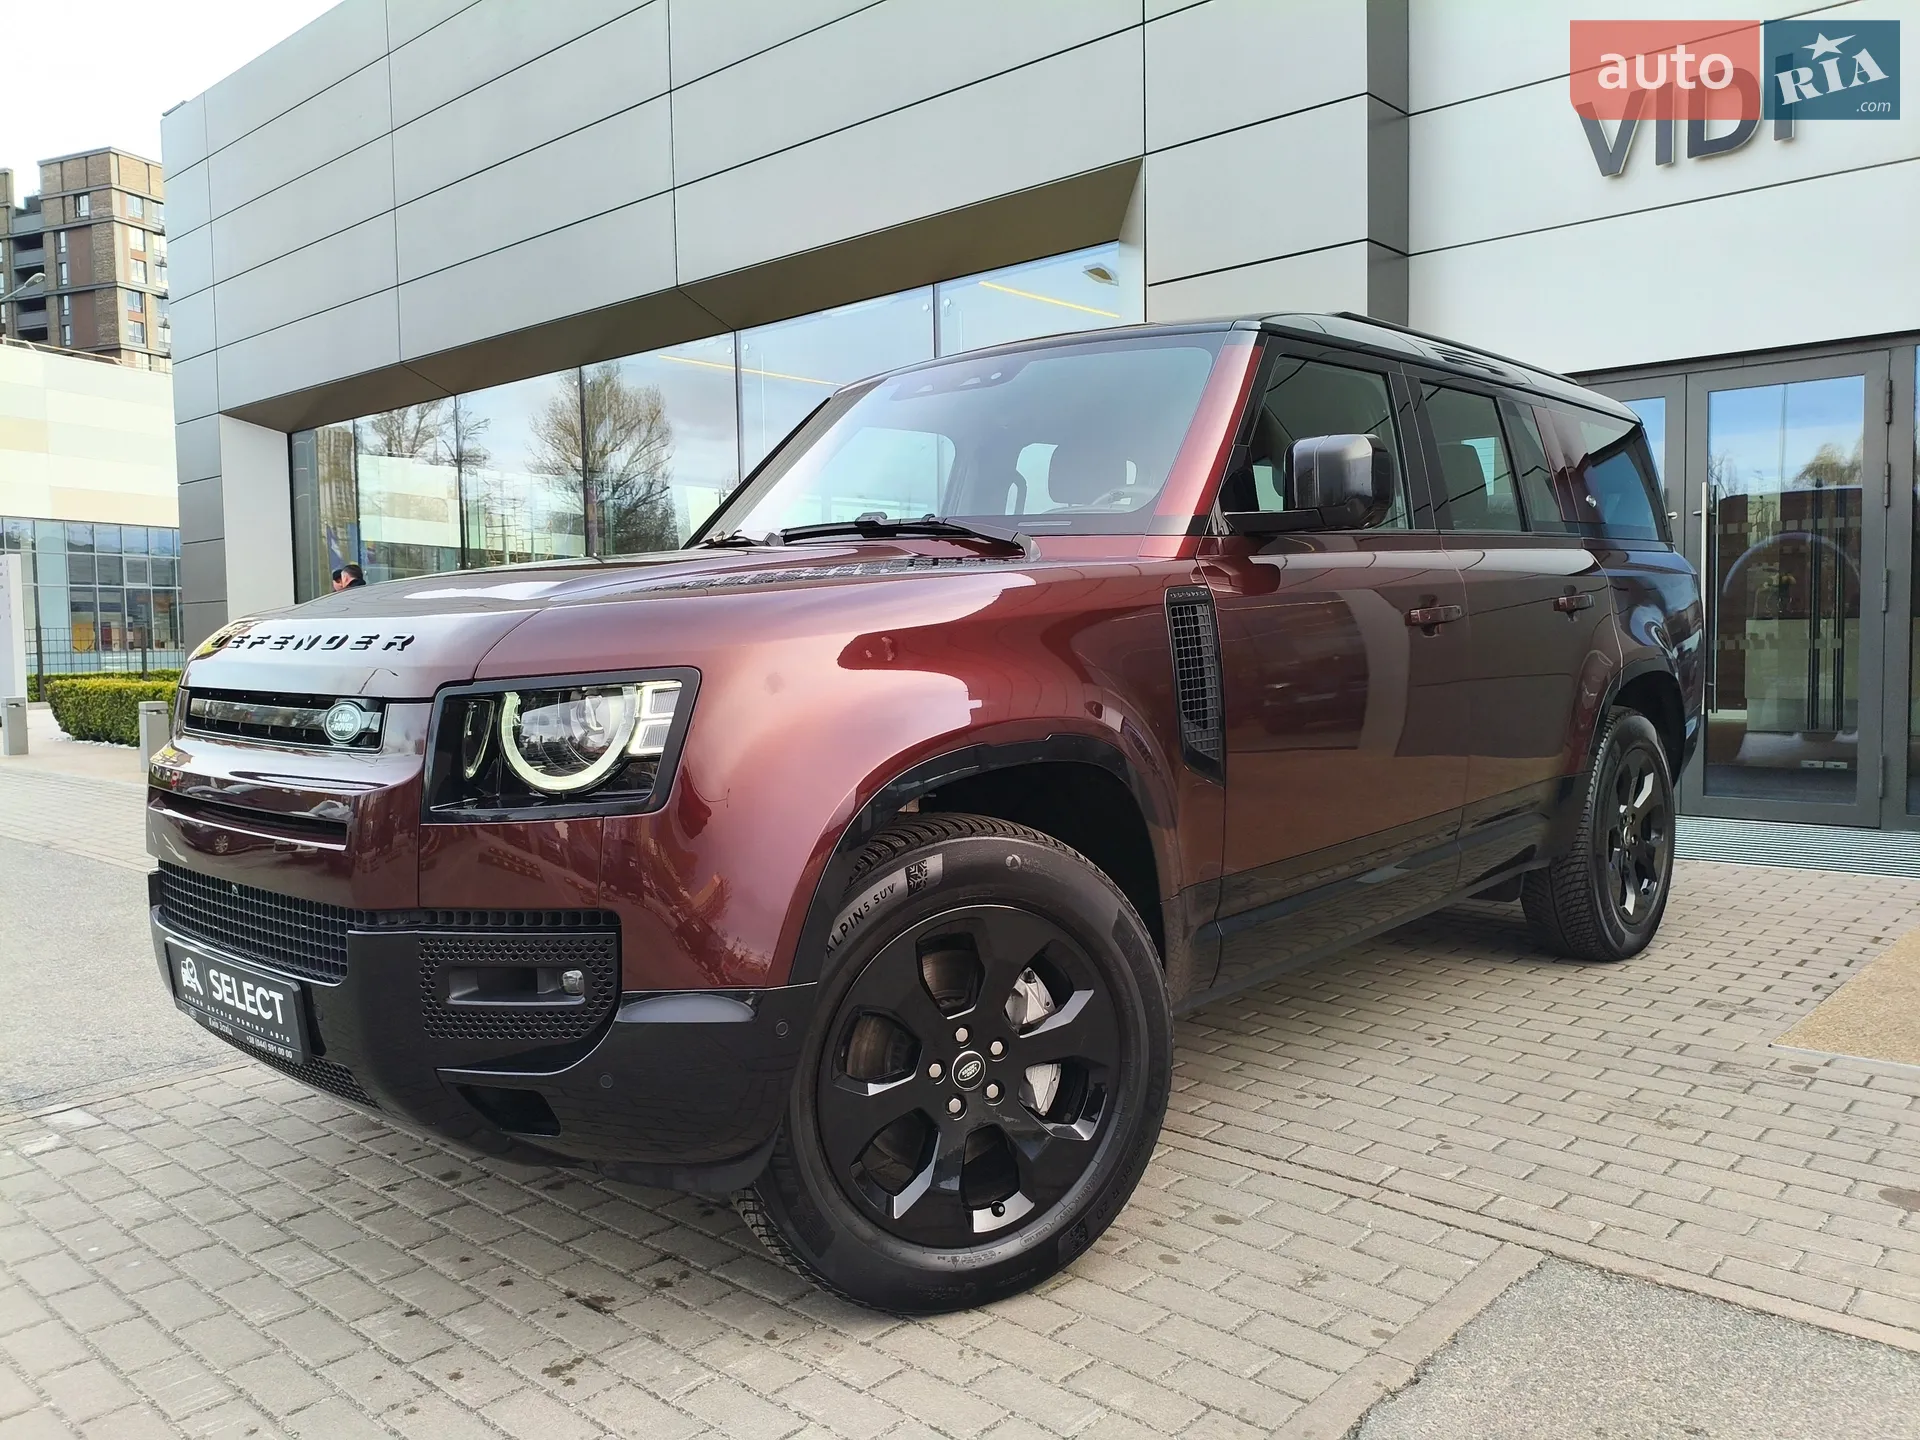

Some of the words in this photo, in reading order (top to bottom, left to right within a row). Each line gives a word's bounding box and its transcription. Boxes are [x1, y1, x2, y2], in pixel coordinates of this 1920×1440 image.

[1576, 53, 1796, 178] VIDI
[333, 722, 354, 732] ROVER
[334, 712, 351, 722] LAND
[873, 882, 897, 905] SUV
[208, 968, 284, 1025] SELECT
